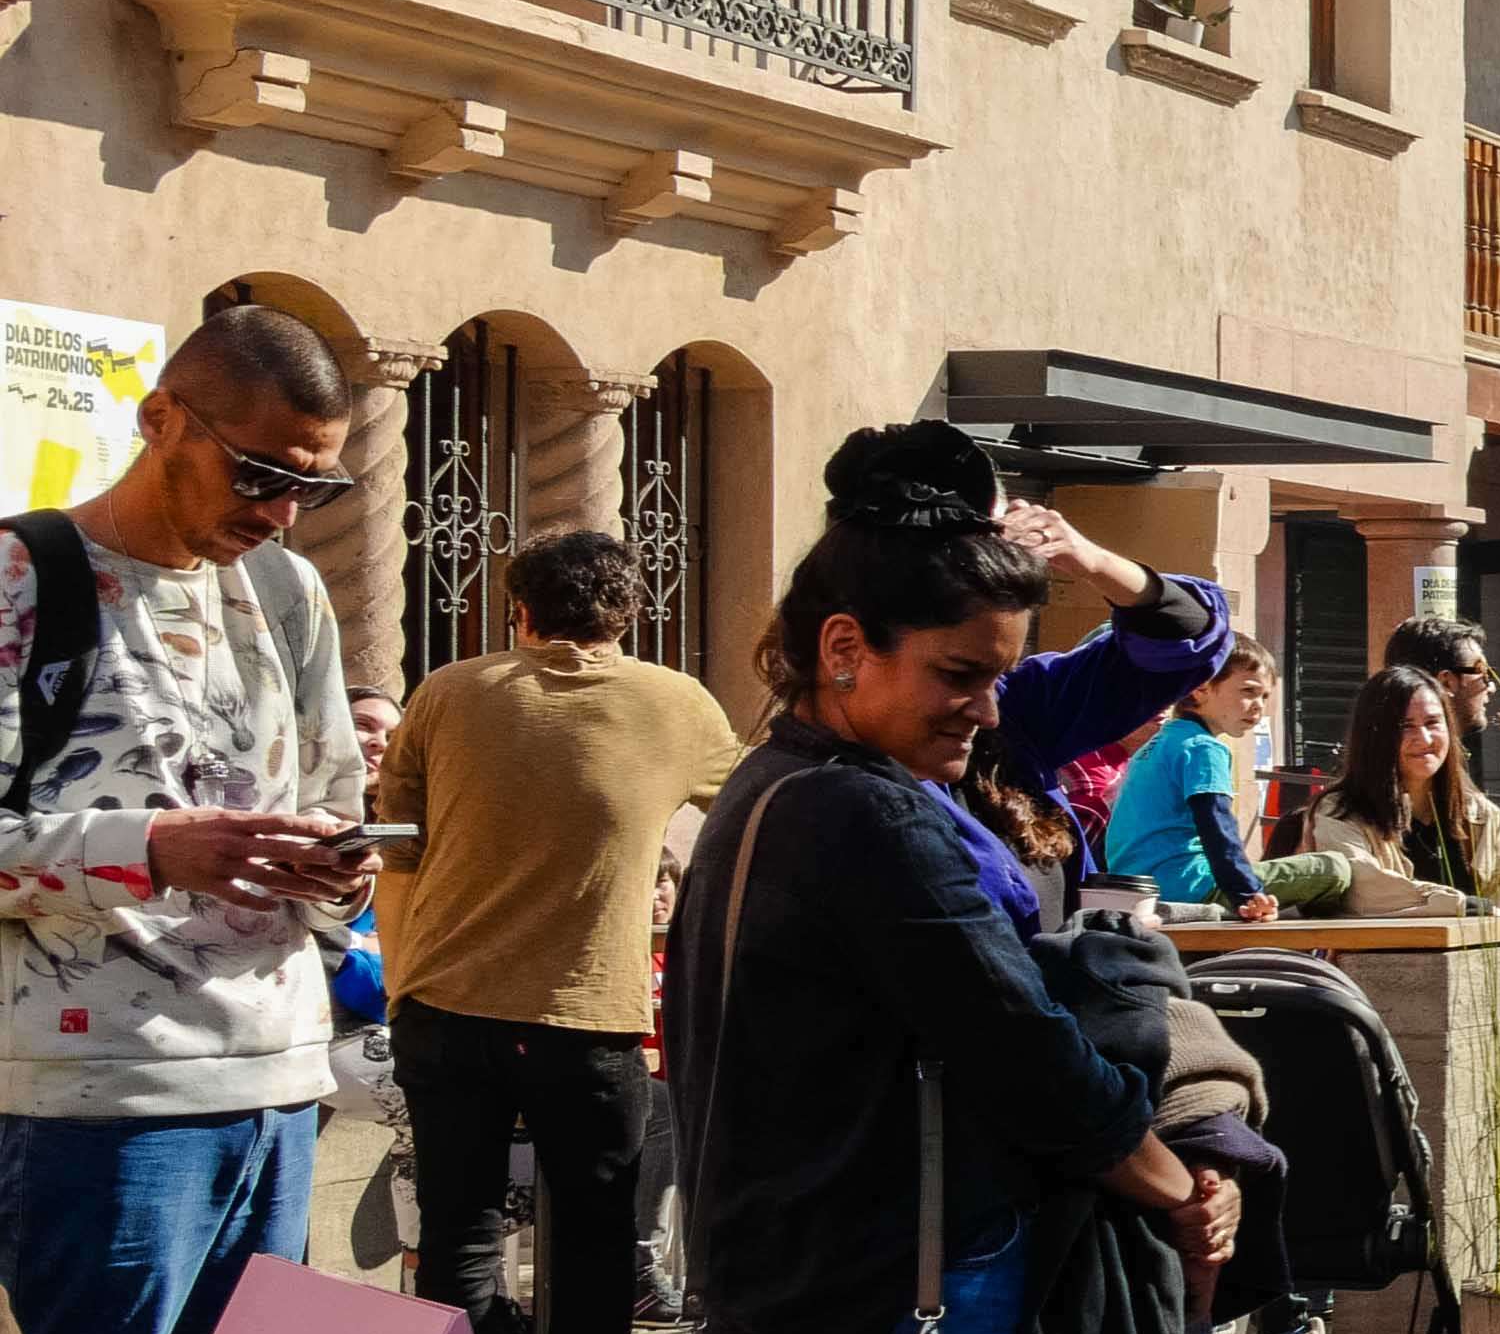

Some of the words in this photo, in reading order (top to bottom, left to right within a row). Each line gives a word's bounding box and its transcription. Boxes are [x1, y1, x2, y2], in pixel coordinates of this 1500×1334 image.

[34, 327, 56, 348] DE
[56, 330, 82, 352] LOS
[5, 345, 104, 378] PATRIMONIOS
